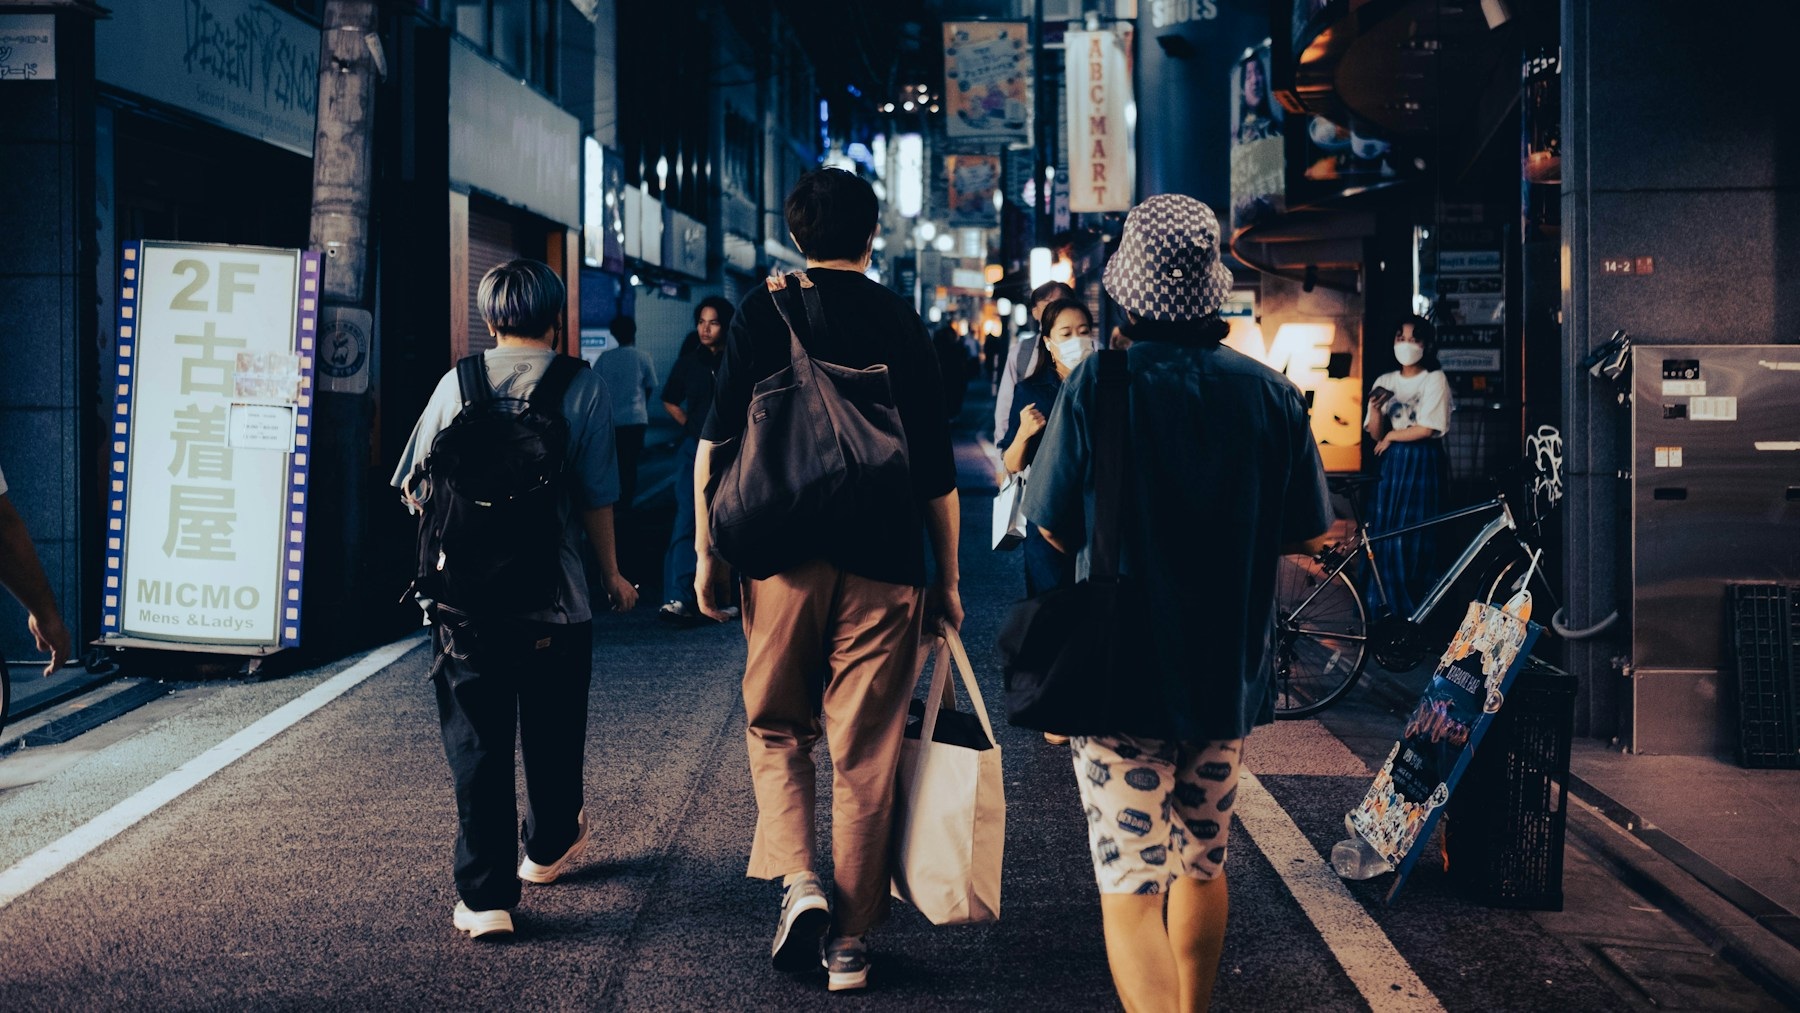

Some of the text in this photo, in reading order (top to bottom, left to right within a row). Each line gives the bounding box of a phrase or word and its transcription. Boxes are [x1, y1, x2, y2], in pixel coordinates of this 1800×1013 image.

[1152, 0, 1218, 28] SHOES
[1605, 261, 1631, 272] 14-2
[169, 259, 260, 313] 2F
[162, 321, 247, 561] 古着屋
[137, 578, 260, 611] MICMO
[139, 609, 254, 632] Mens &Ladys
